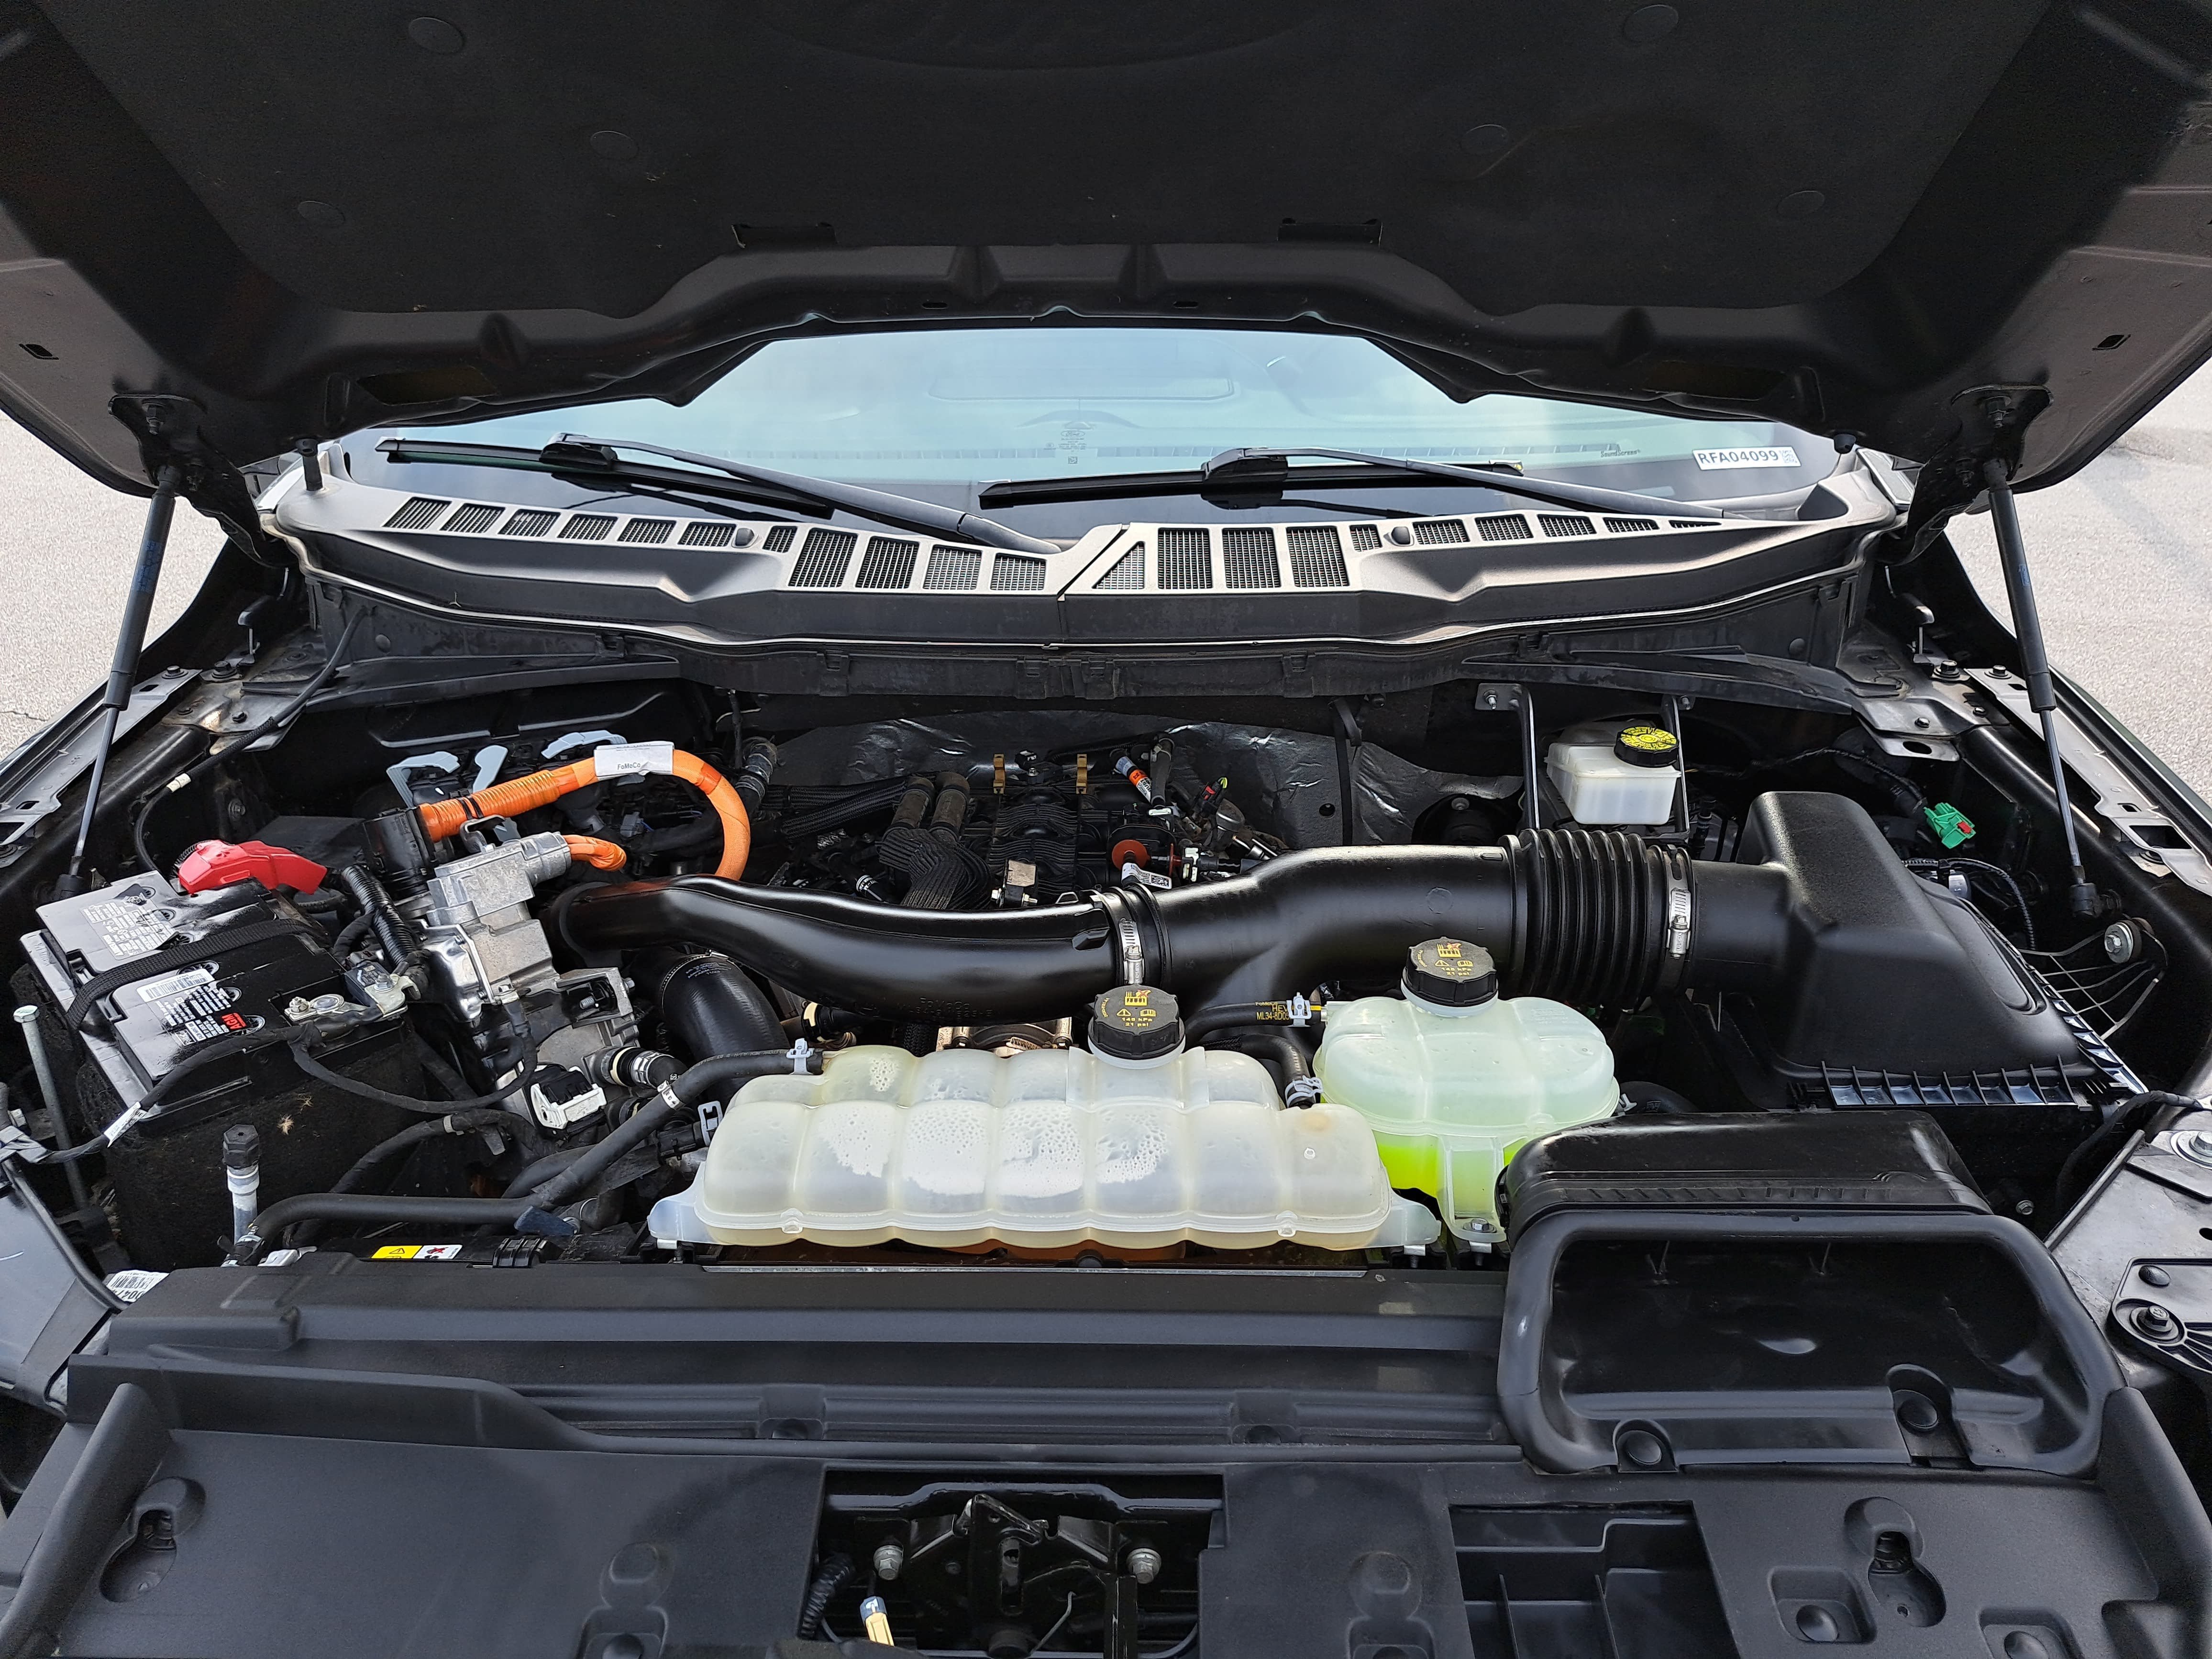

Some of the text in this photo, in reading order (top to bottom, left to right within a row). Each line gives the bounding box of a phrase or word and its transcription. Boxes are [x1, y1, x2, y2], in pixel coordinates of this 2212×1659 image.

[1698, 450, 1779, 465] RFA04099
[617, 762, 641, 770] FoMoCo
[221, 1013, 243, 1029] AGM
